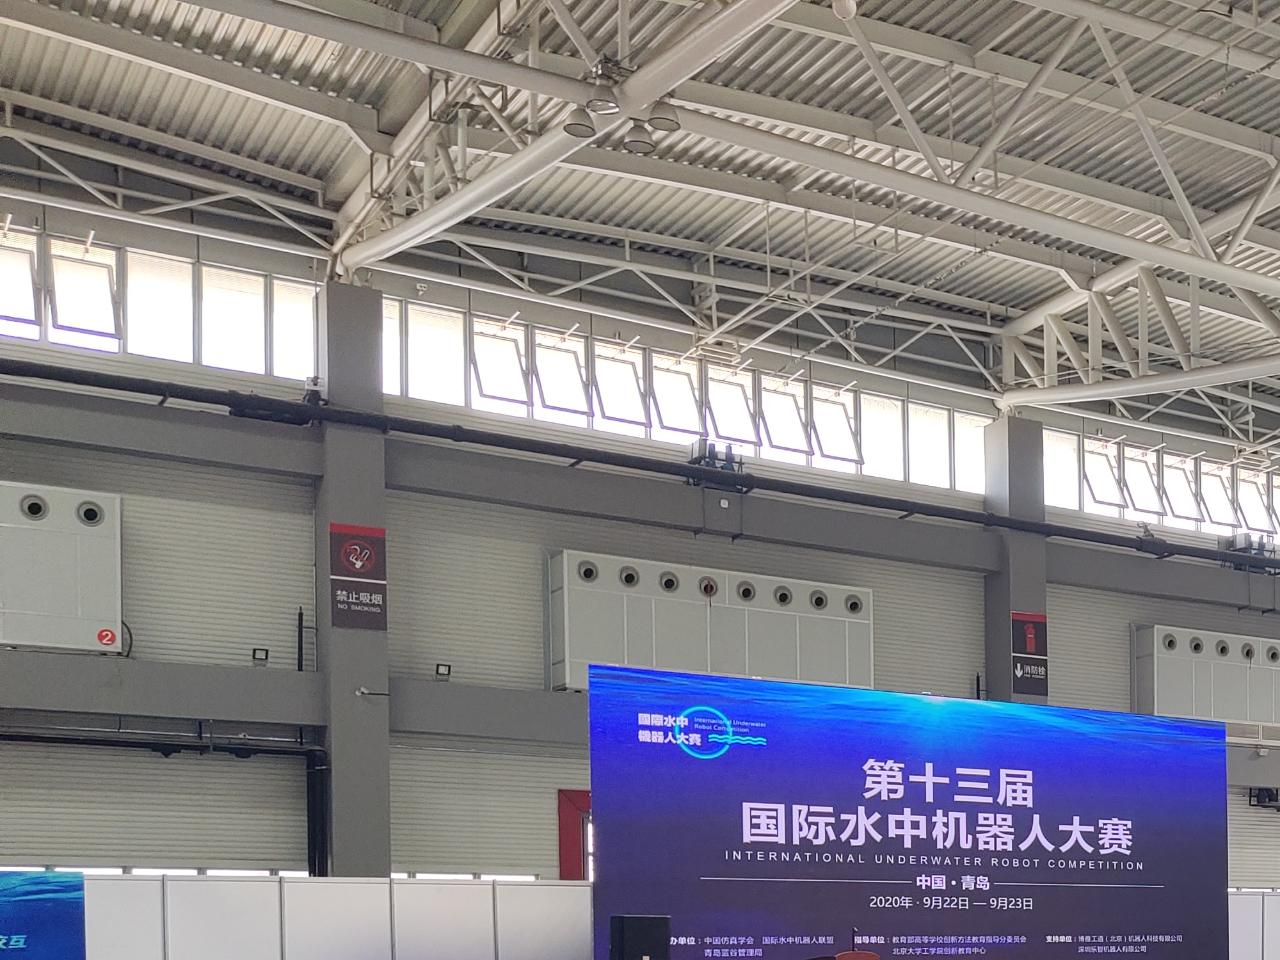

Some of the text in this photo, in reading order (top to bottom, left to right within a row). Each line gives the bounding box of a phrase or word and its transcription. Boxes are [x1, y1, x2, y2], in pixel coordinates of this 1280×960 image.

[336, 590, 383, 605] 禁止吸烟
[101, 630, 113, 645] 2
[1023, 664, 1047, 676] 消防栓
[638, 713, 689, 728] 國際水中
[862, 758, 1034, 808] 第十三届
[742, 802, 1133, 856] 国际水中机器人大赛
[725, 850, 1144, 871] INTERNATIONAL UNDERWATER ROBOT COMPETITION
[762, 936, 834, 945] 国际水中机器人联盟
